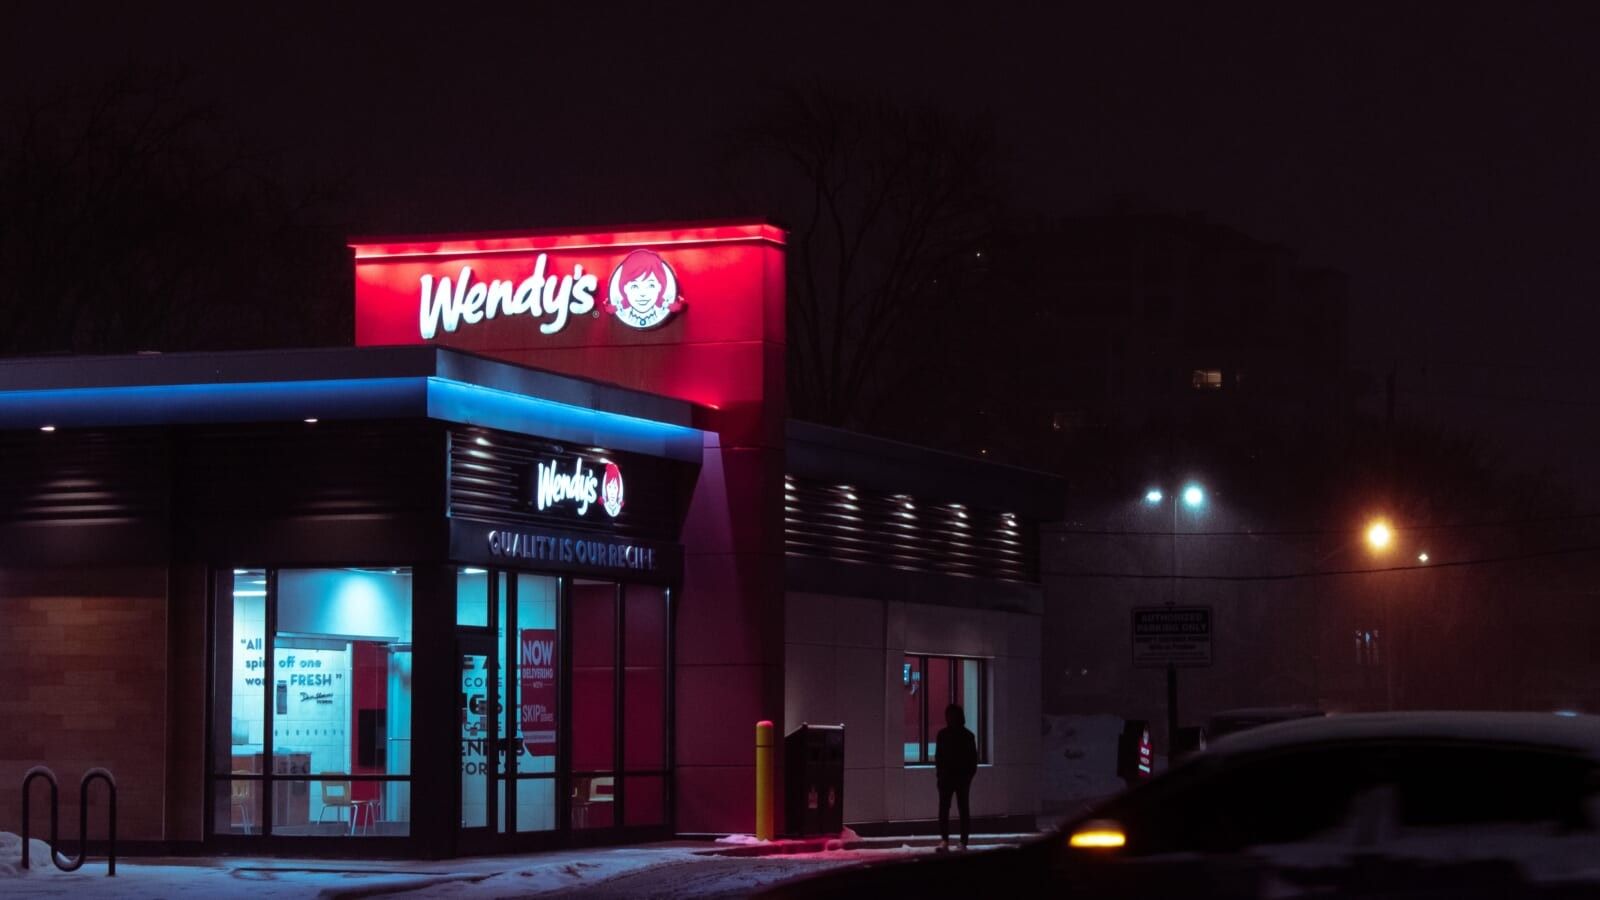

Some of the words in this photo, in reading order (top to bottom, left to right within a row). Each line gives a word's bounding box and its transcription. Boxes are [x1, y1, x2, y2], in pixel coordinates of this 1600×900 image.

[420, 253, 598, 339] Wendy's
[538, 457, 598, 516] Wendy's
[488, 530, 556, 561] QUALITY
[559, 538, 573, 563] IS
[575, 539, 608, 566] OUR
[1182, 623, 1207, 633] ONLY
[278, 655, 296, 668] off
[299, 659, 322, 668] one
[522, 639, 554, 666] NOW
[522, 668, 553, 679] DELIVERING
[522, 704, 541, 722] SKIP
